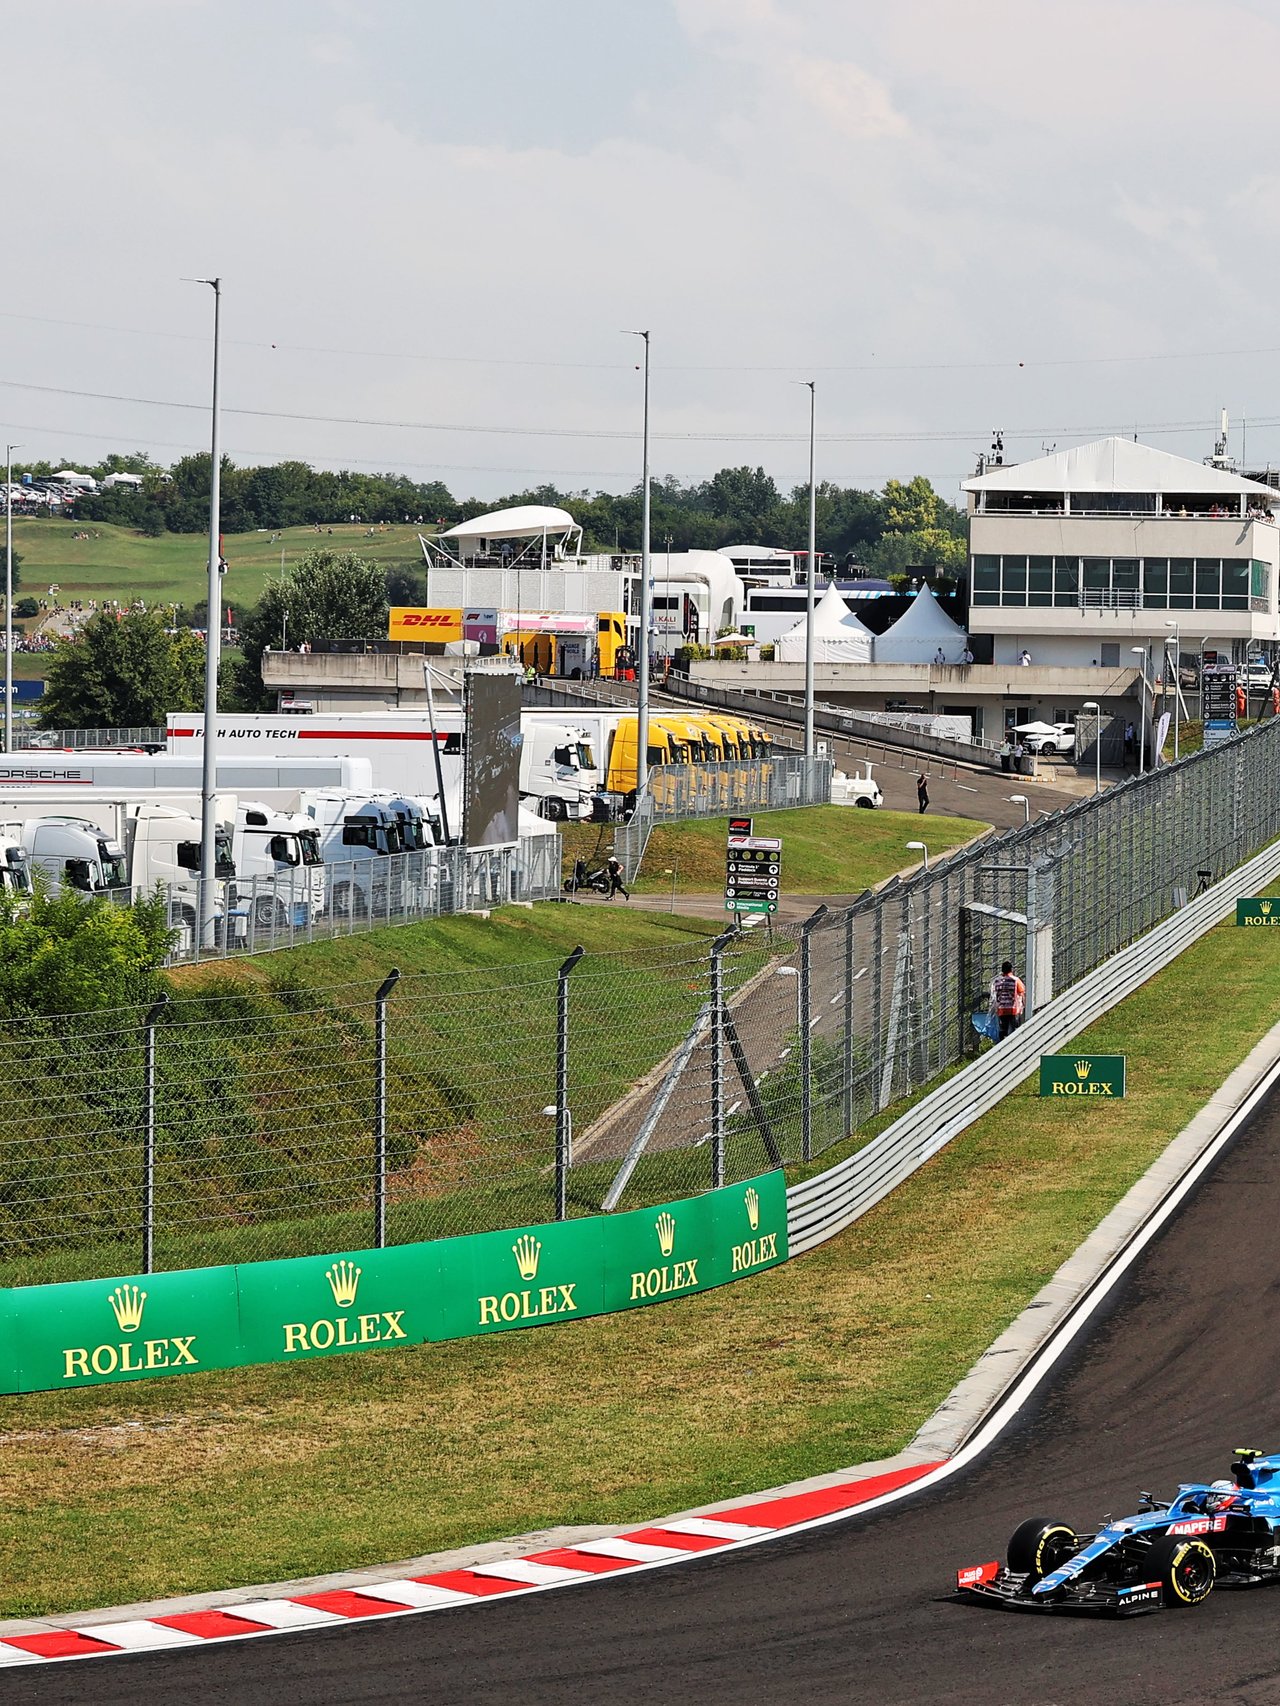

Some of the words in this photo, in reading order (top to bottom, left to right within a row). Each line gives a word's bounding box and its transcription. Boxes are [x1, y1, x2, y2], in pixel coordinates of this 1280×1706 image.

[402, 614, 454, 627] DHL
[229, 729, 262, 738] AUTO
[265, 730, 297, 739] TECH
[0, 770, 80, 779] ORSCHE
[1051, 1082, 1113, 1095] ROLEX
[731, 1232, 778, 1273] ROLEX
[629, 1258, 699, 1301] ROLEX
[478, 1283, 577, 1325] ROLEX
[282, 1310, 408, 1353] ROLEX
[62, 1335, 199, 1379] ROLEX
[1174, 1519, 1222, 1535] MAPFRE
[1119, 1590, 1159, 1606] ALPINE
